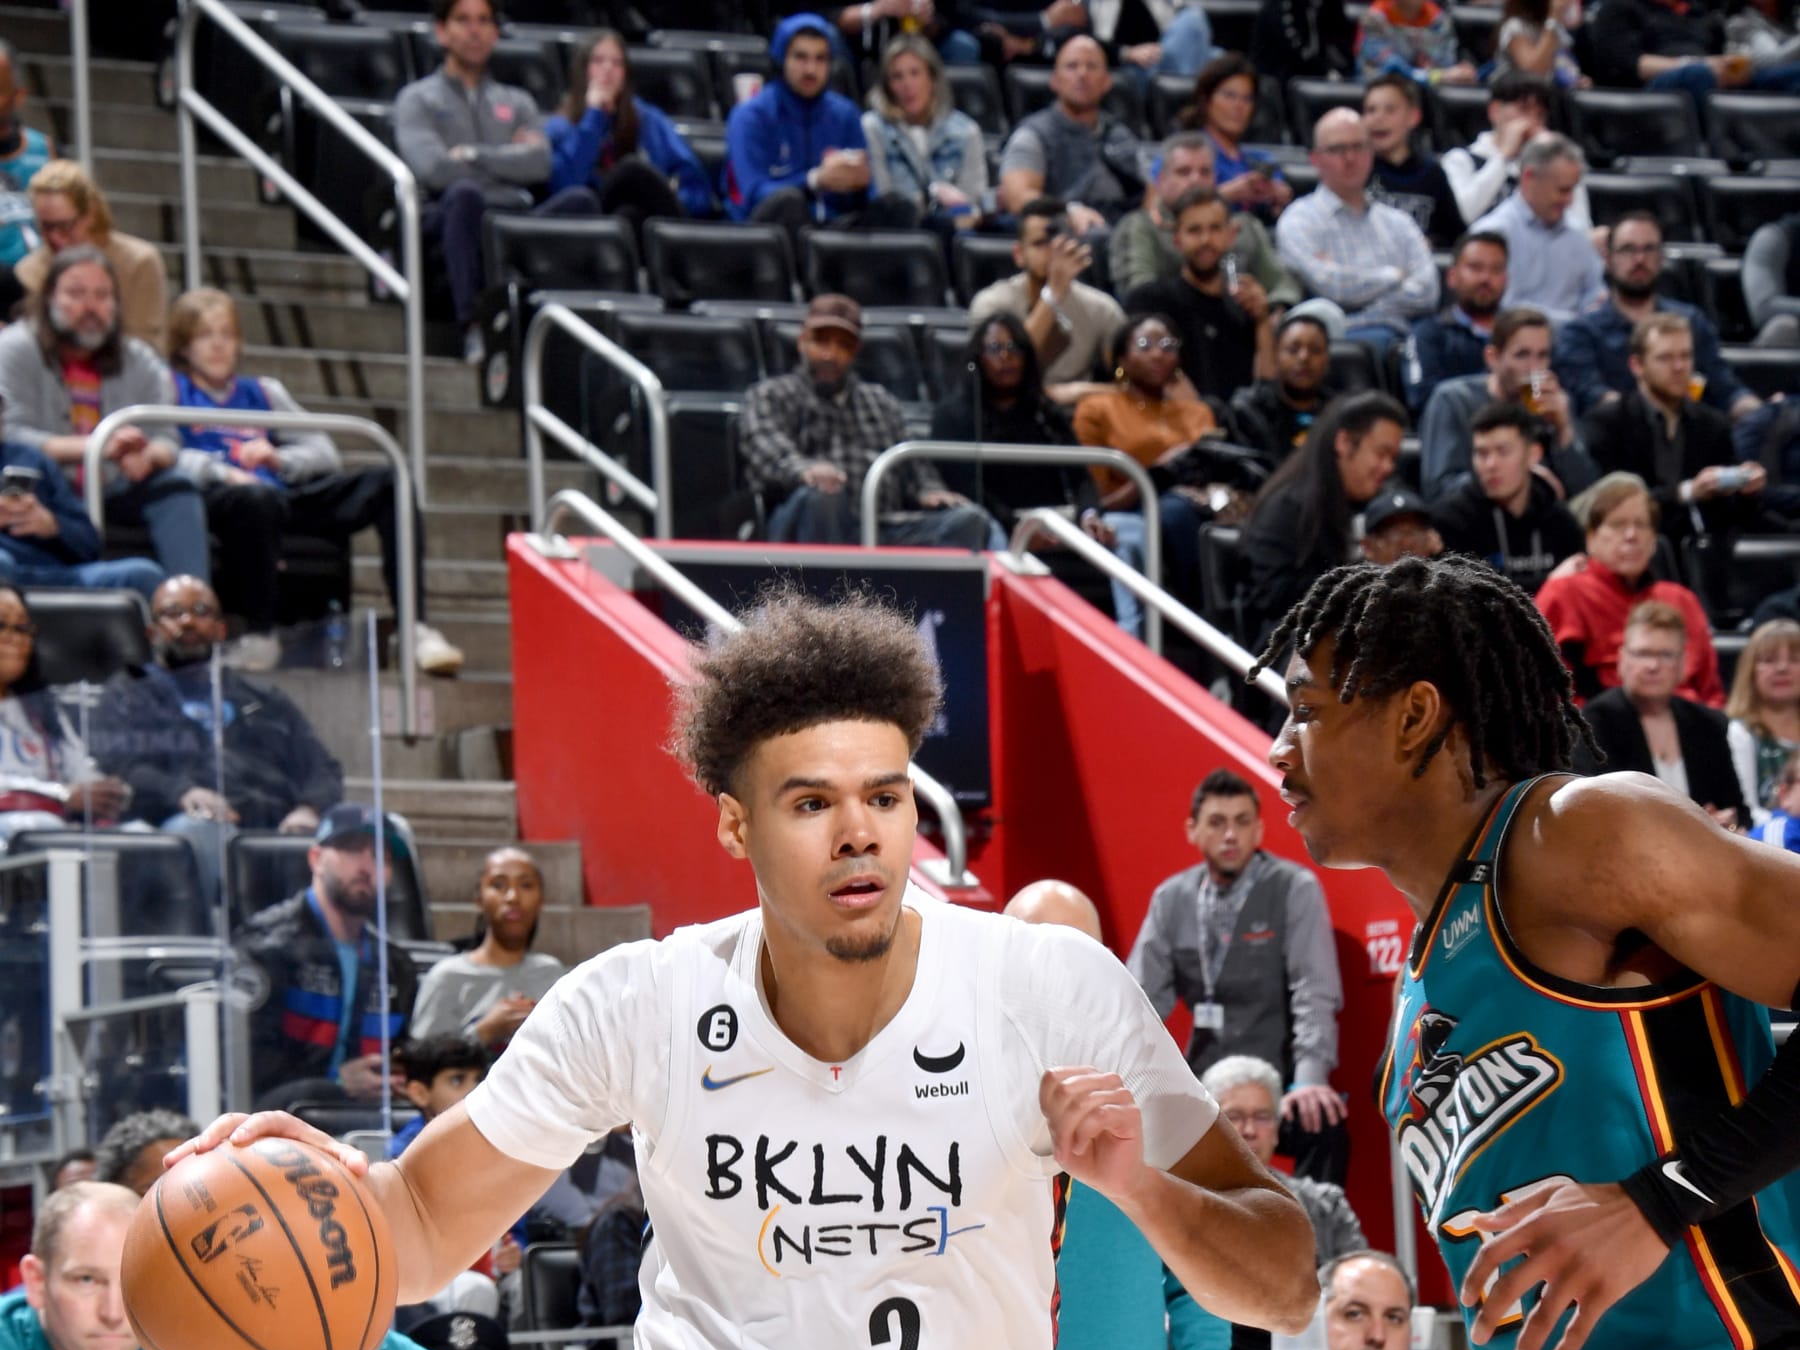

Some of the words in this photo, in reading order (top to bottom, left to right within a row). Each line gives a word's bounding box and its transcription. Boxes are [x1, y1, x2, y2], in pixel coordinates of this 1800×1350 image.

[1443, 902, 1480, 948] UWM
[1367, 937, 1402, 974] 122
[708, 1011, 731, 1047] 6
[915, 1081, 969, 1099] Webull
[705, 1134, 962, 1212] BKLYN
